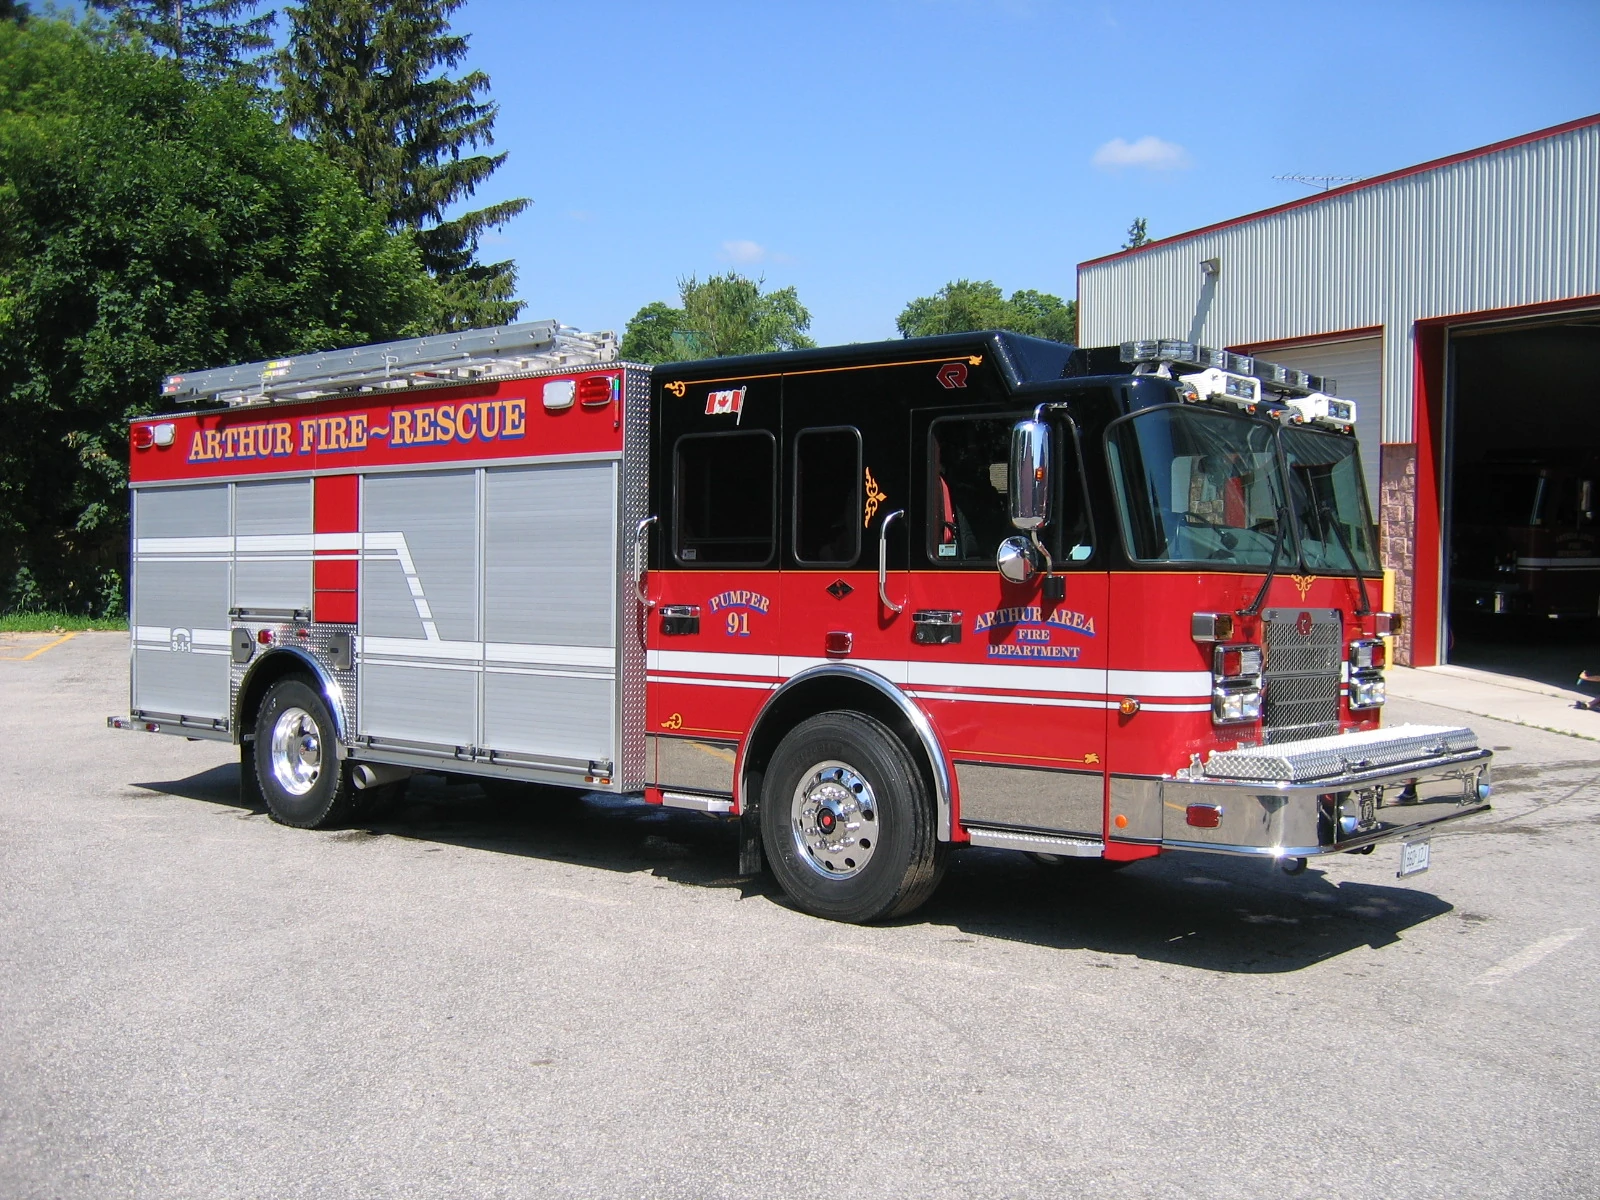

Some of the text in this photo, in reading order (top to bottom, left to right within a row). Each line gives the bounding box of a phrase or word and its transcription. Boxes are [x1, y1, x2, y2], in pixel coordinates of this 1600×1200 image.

[188, 421, 294, 462] ARTHUR
[709, 590, 770, 613] PUMPER
[727, 612, 750, 636] 91
[975, 606, 1095, 636] ARTHUR AREA
[1018, 629, 1050, 642] FIRE
[988, 644, 1080, 660] DEPARTMENT
